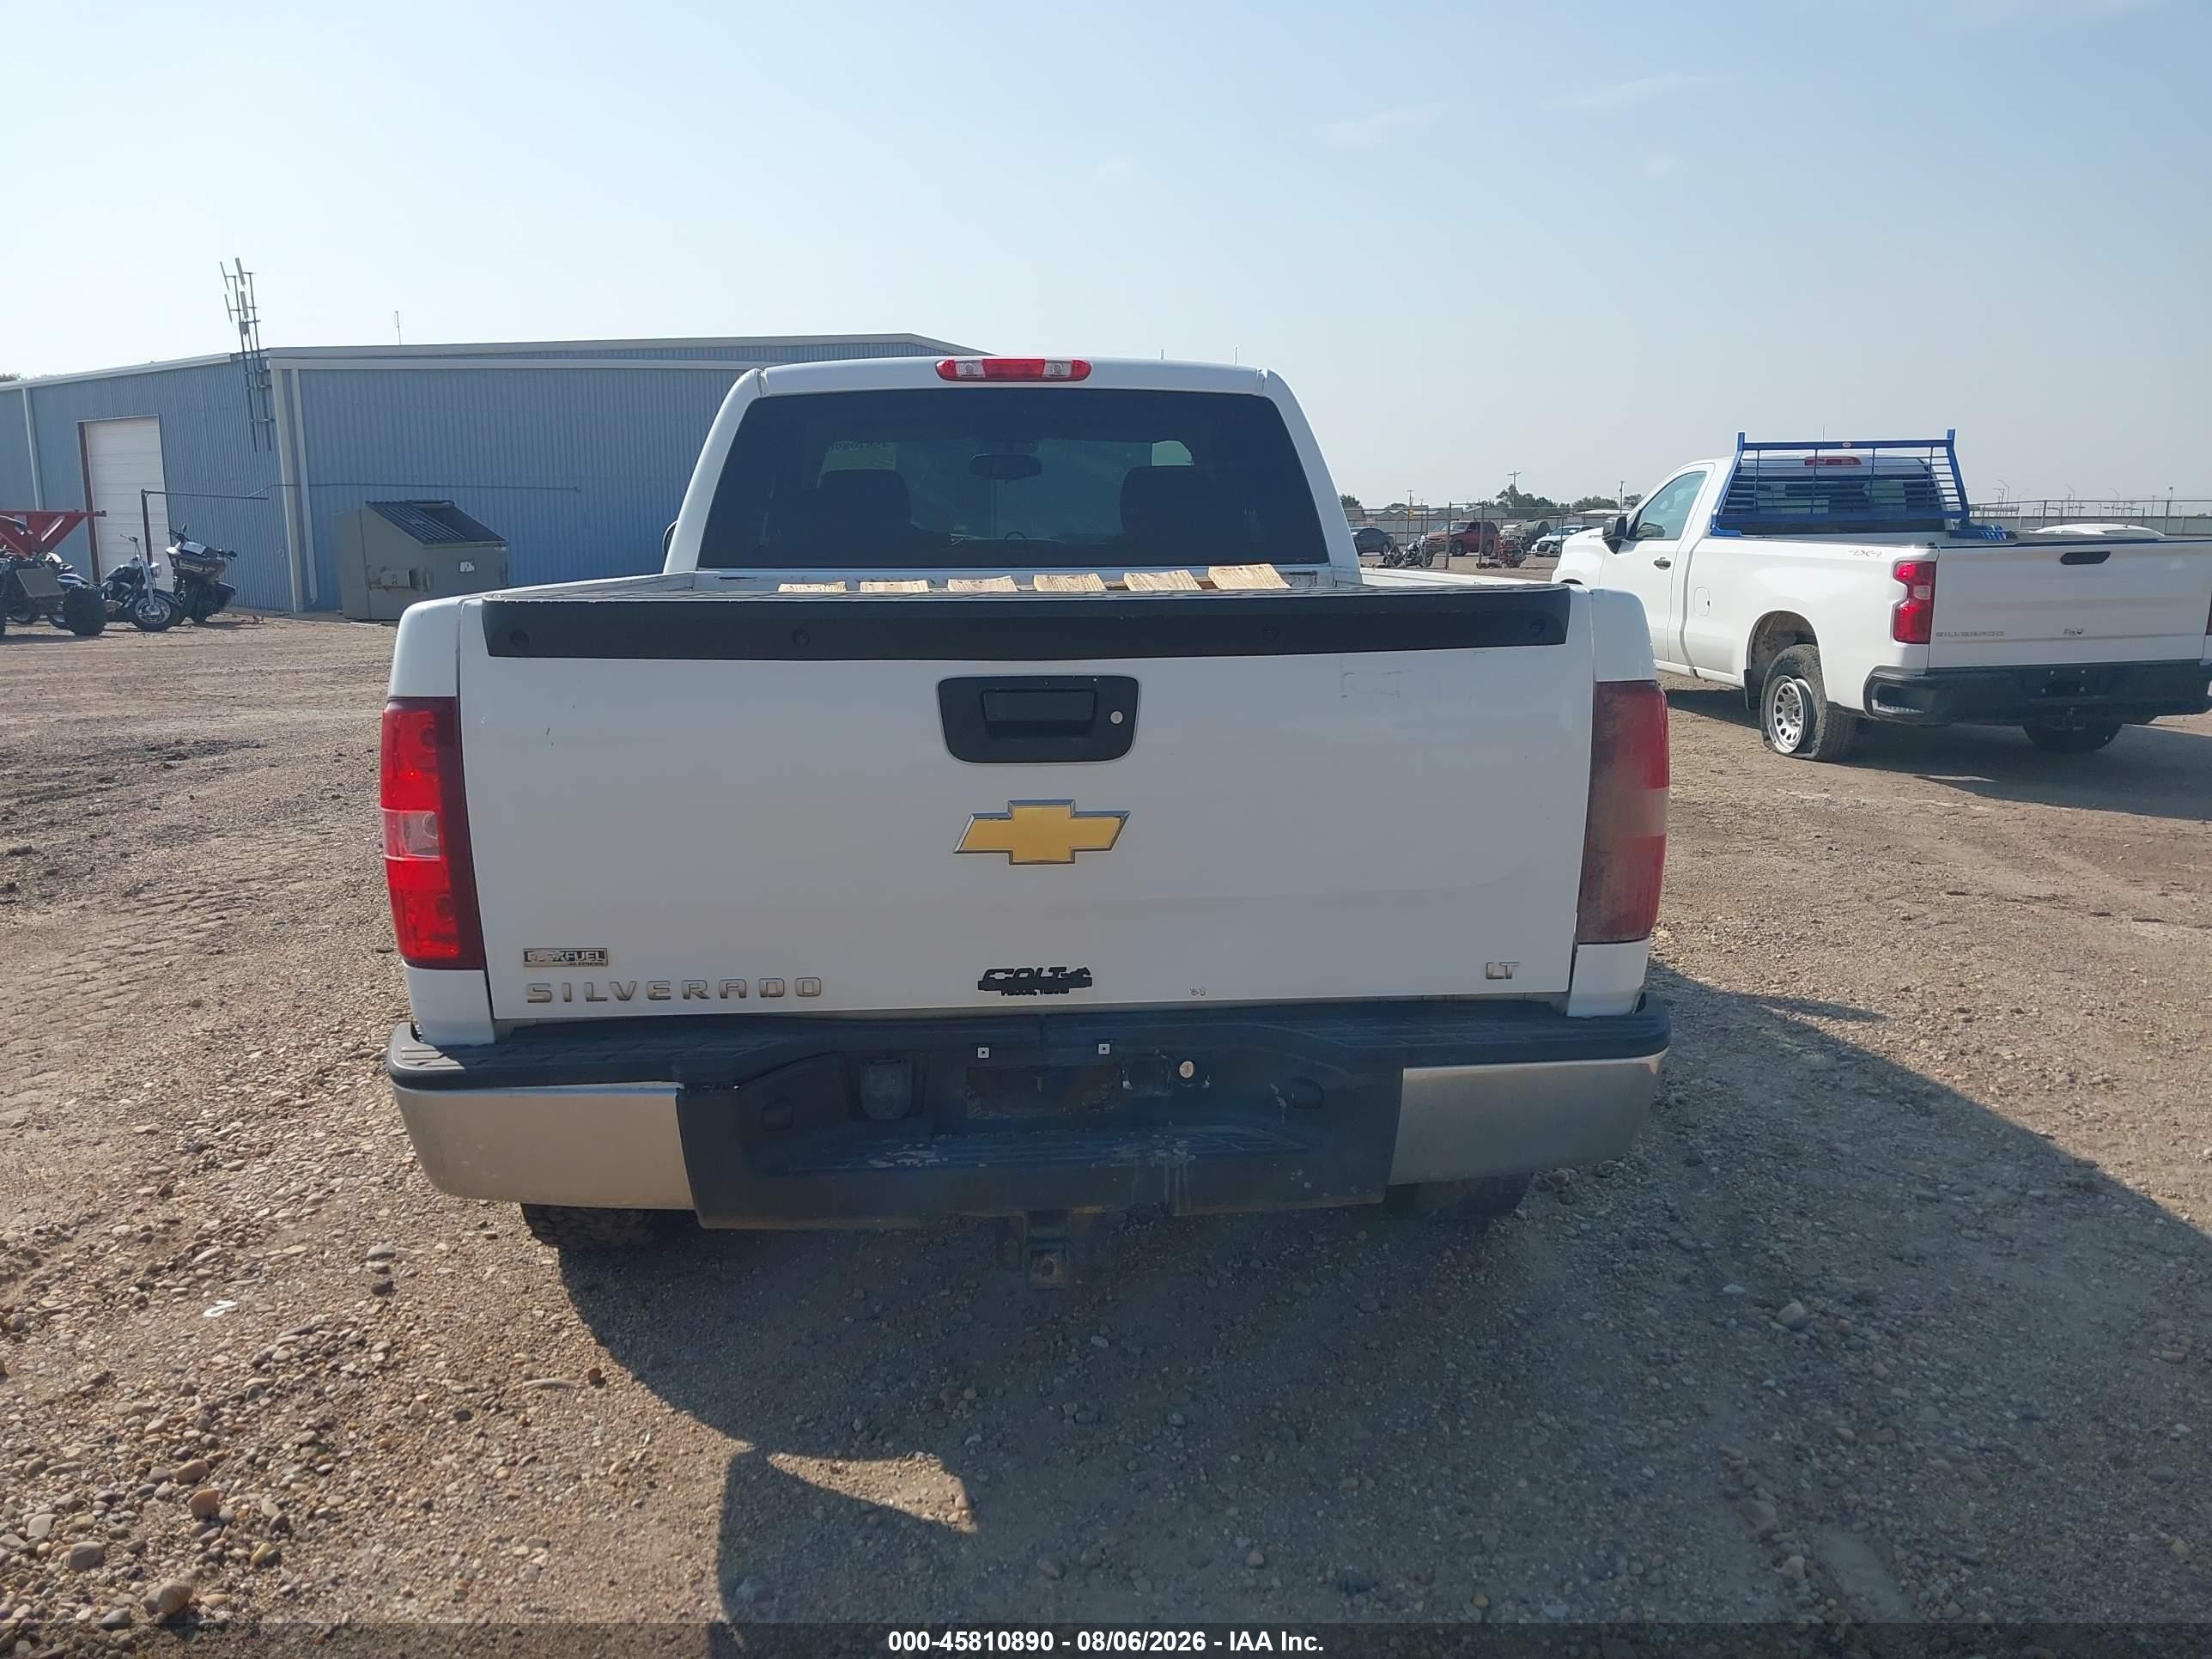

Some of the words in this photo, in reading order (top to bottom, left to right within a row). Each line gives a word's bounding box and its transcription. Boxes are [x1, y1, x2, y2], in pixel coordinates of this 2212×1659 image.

[981, 967, 1068, 985] COLT
[1486, 962, 1519, 980] LT
[526, 976, 822, 1004] SILVERADO
